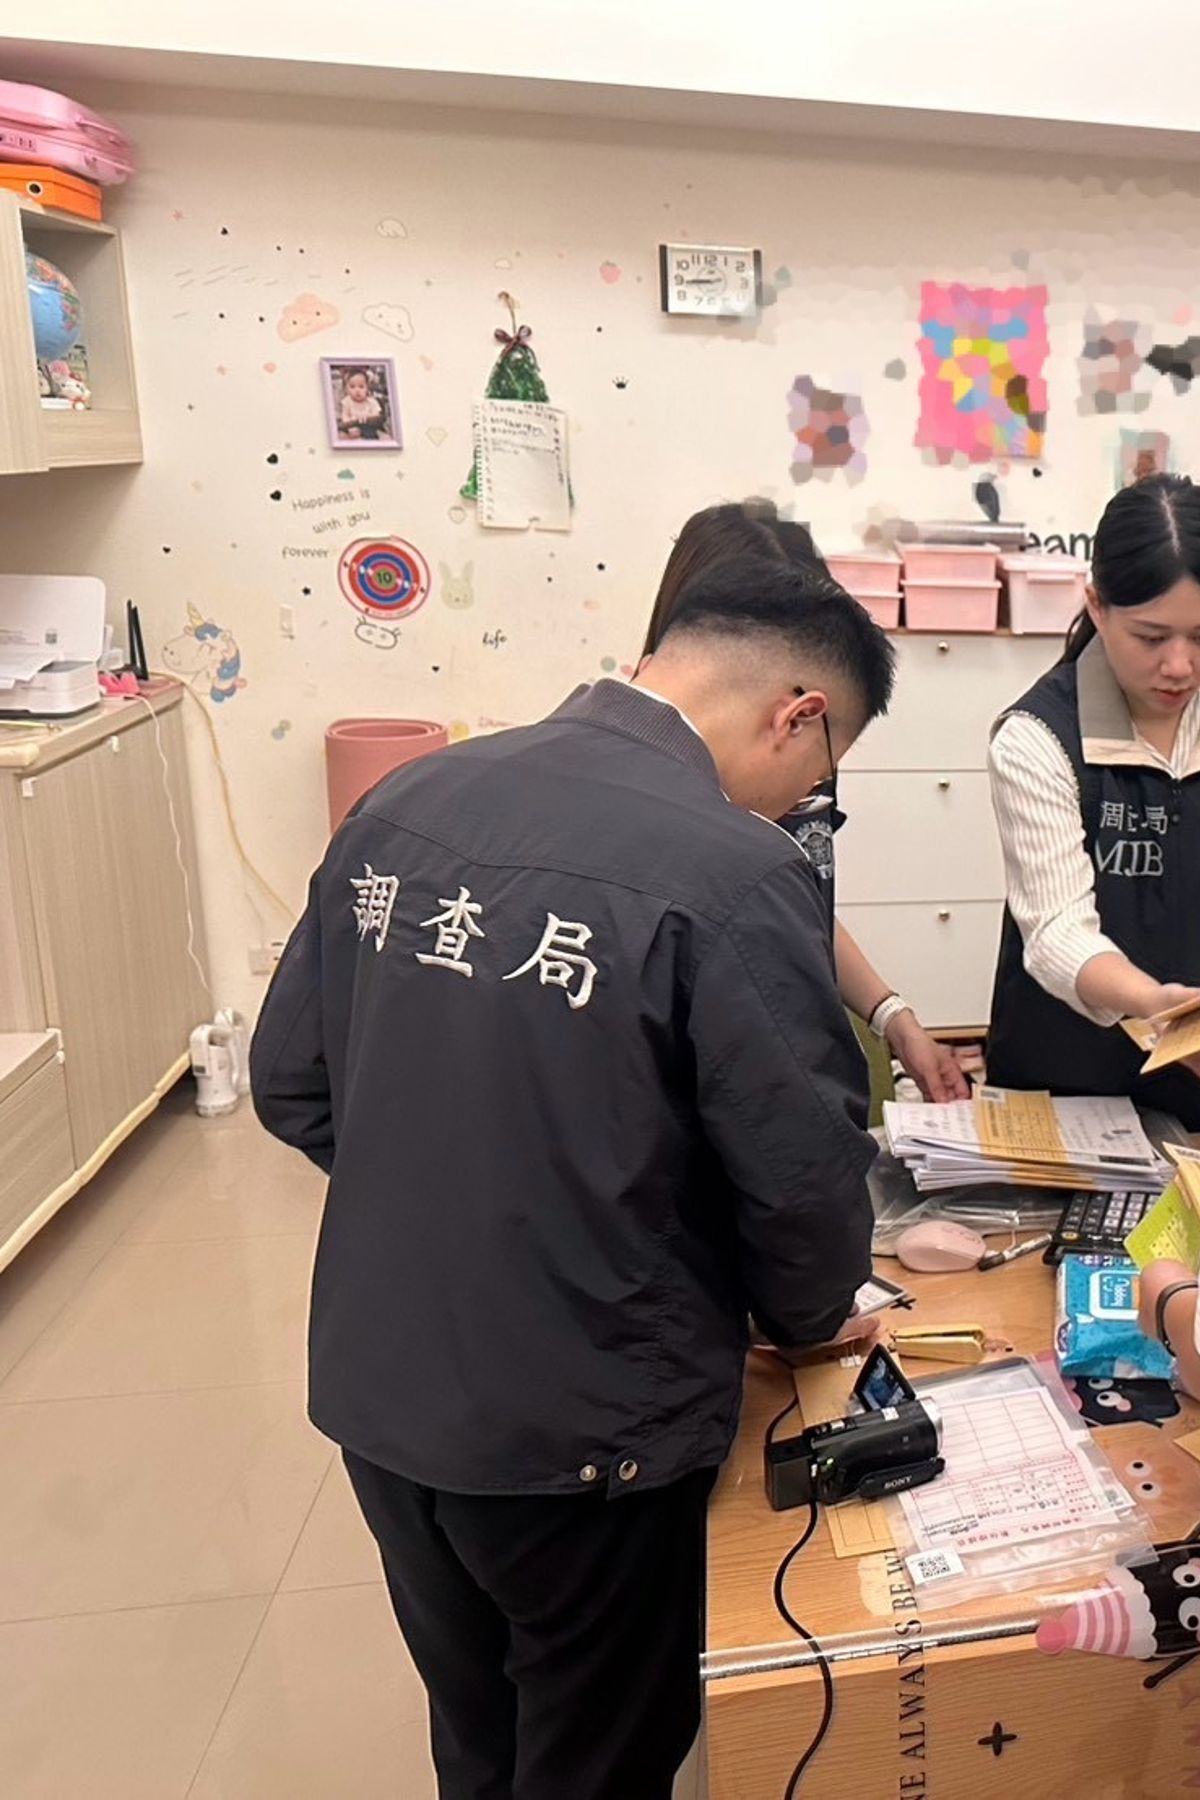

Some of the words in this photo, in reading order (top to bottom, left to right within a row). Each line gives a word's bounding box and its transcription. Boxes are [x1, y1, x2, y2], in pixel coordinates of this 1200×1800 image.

[676, 259, 690, 271] 10
[704, 254, 718, 266] 12
[736, 260, 746, 273] 2
[674, 273, 685, 286] 9
[292, 491, 355, 511] Happiness
[312, 518, 341, 534] with
[346, 511, 371, 527] you
[282, 546, 329, 559] forever
[376, 571, 393, 585] 10
[349, 863, 598, 1010] 調查局
[883, 1475, 913, 1490] SONY
[895, 1618, 927, 1761] ALWAYS
